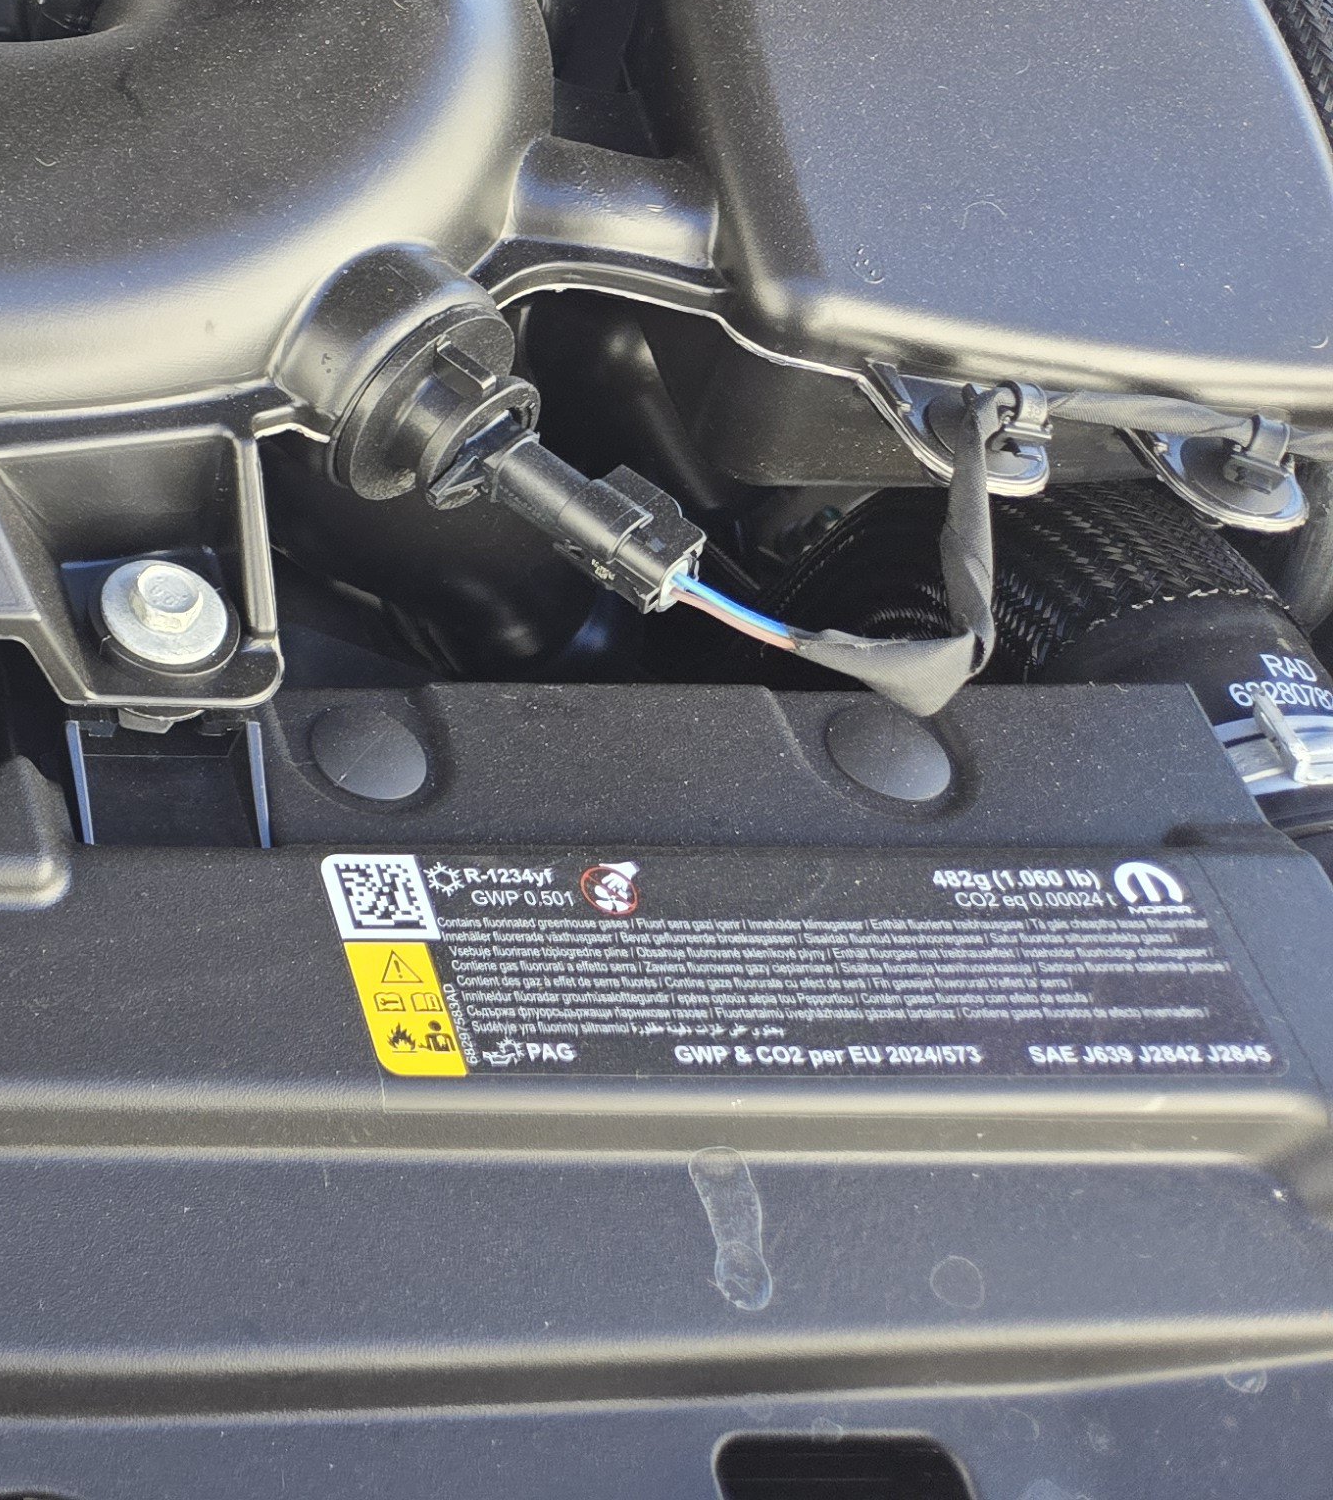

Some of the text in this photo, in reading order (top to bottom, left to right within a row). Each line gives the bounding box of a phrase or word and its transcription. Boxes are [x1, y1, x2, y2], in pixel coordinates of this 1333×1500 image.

[1260, 654, 1317, 682] RAD
[464, 867, 553, 887] R-1234yf
[933, 869, 1101, 891] 482g (1.060 lb)
[471, 890, 519, 907] GWP
[954, 892, 1000, 907] CO2
[1002, 894, 1030, 912] eq
[1032, 892, 1102, 908] 0.00024
[1128, 905, 1194, 914] MOPAR
[437, 918, 481, 929] Contains
[483, 918, 535, 929] fluorinated
[538, 918, 596, 931] greenhouse
[599, 920, 629, 932] gases
[451, 961, 496, 972] Contiene
[498, 963, 519, 975] gas
[456, 976, 500, 988] Contient
[501, 976, 520, 988] des
[522, 978, 542, 990] gaz
[552, 976, 576, 988] effet
[593, 978, 620, 988] serre
[443, 983, 479, 1065] 68297583AD
[526, 1043, 575, 1062] PAG
[674, 1045, 982, 1068] GWP & CO2 per EU 2024/573
[1028, 1045, 1272, 1063] SAE J639 J2842 J2845
